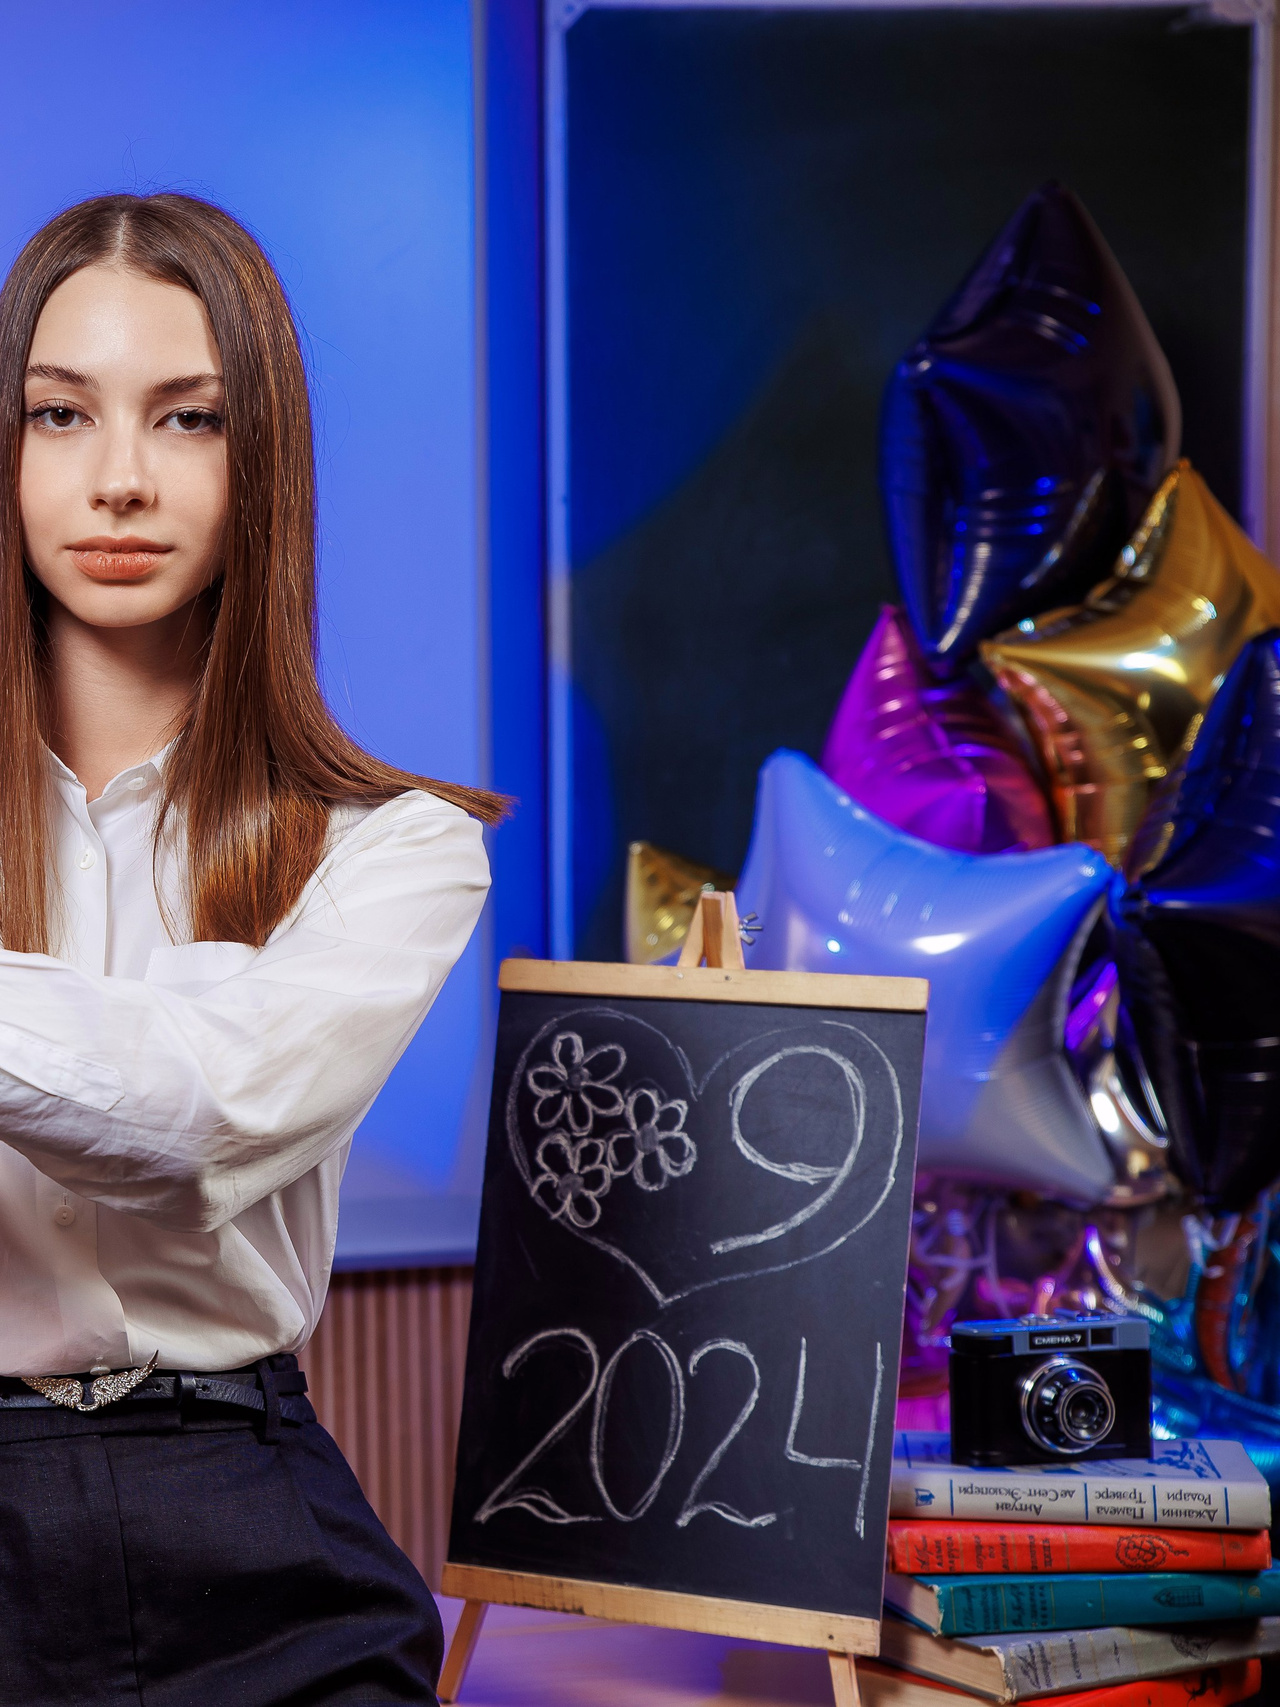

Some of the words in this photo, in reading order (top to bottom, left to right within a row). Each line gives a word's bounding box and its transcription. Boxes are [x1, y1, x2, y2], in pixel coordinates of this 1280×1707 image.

[710, 1045, 866, 1254] 9
[1034, 1334, 1082, 1345] СМЕНА-7
[473, 1329, 884, 1539] 2024
[1094, 1489, 1146, 1504] Трэверс
[1166, 1491, 1212, 1505] Родари
[996, 1501, 1043, 1516] Антуан
[1096, 1505, 1145, 1520] Памела
[1161, 1507, 1218, 1523] Джанни
